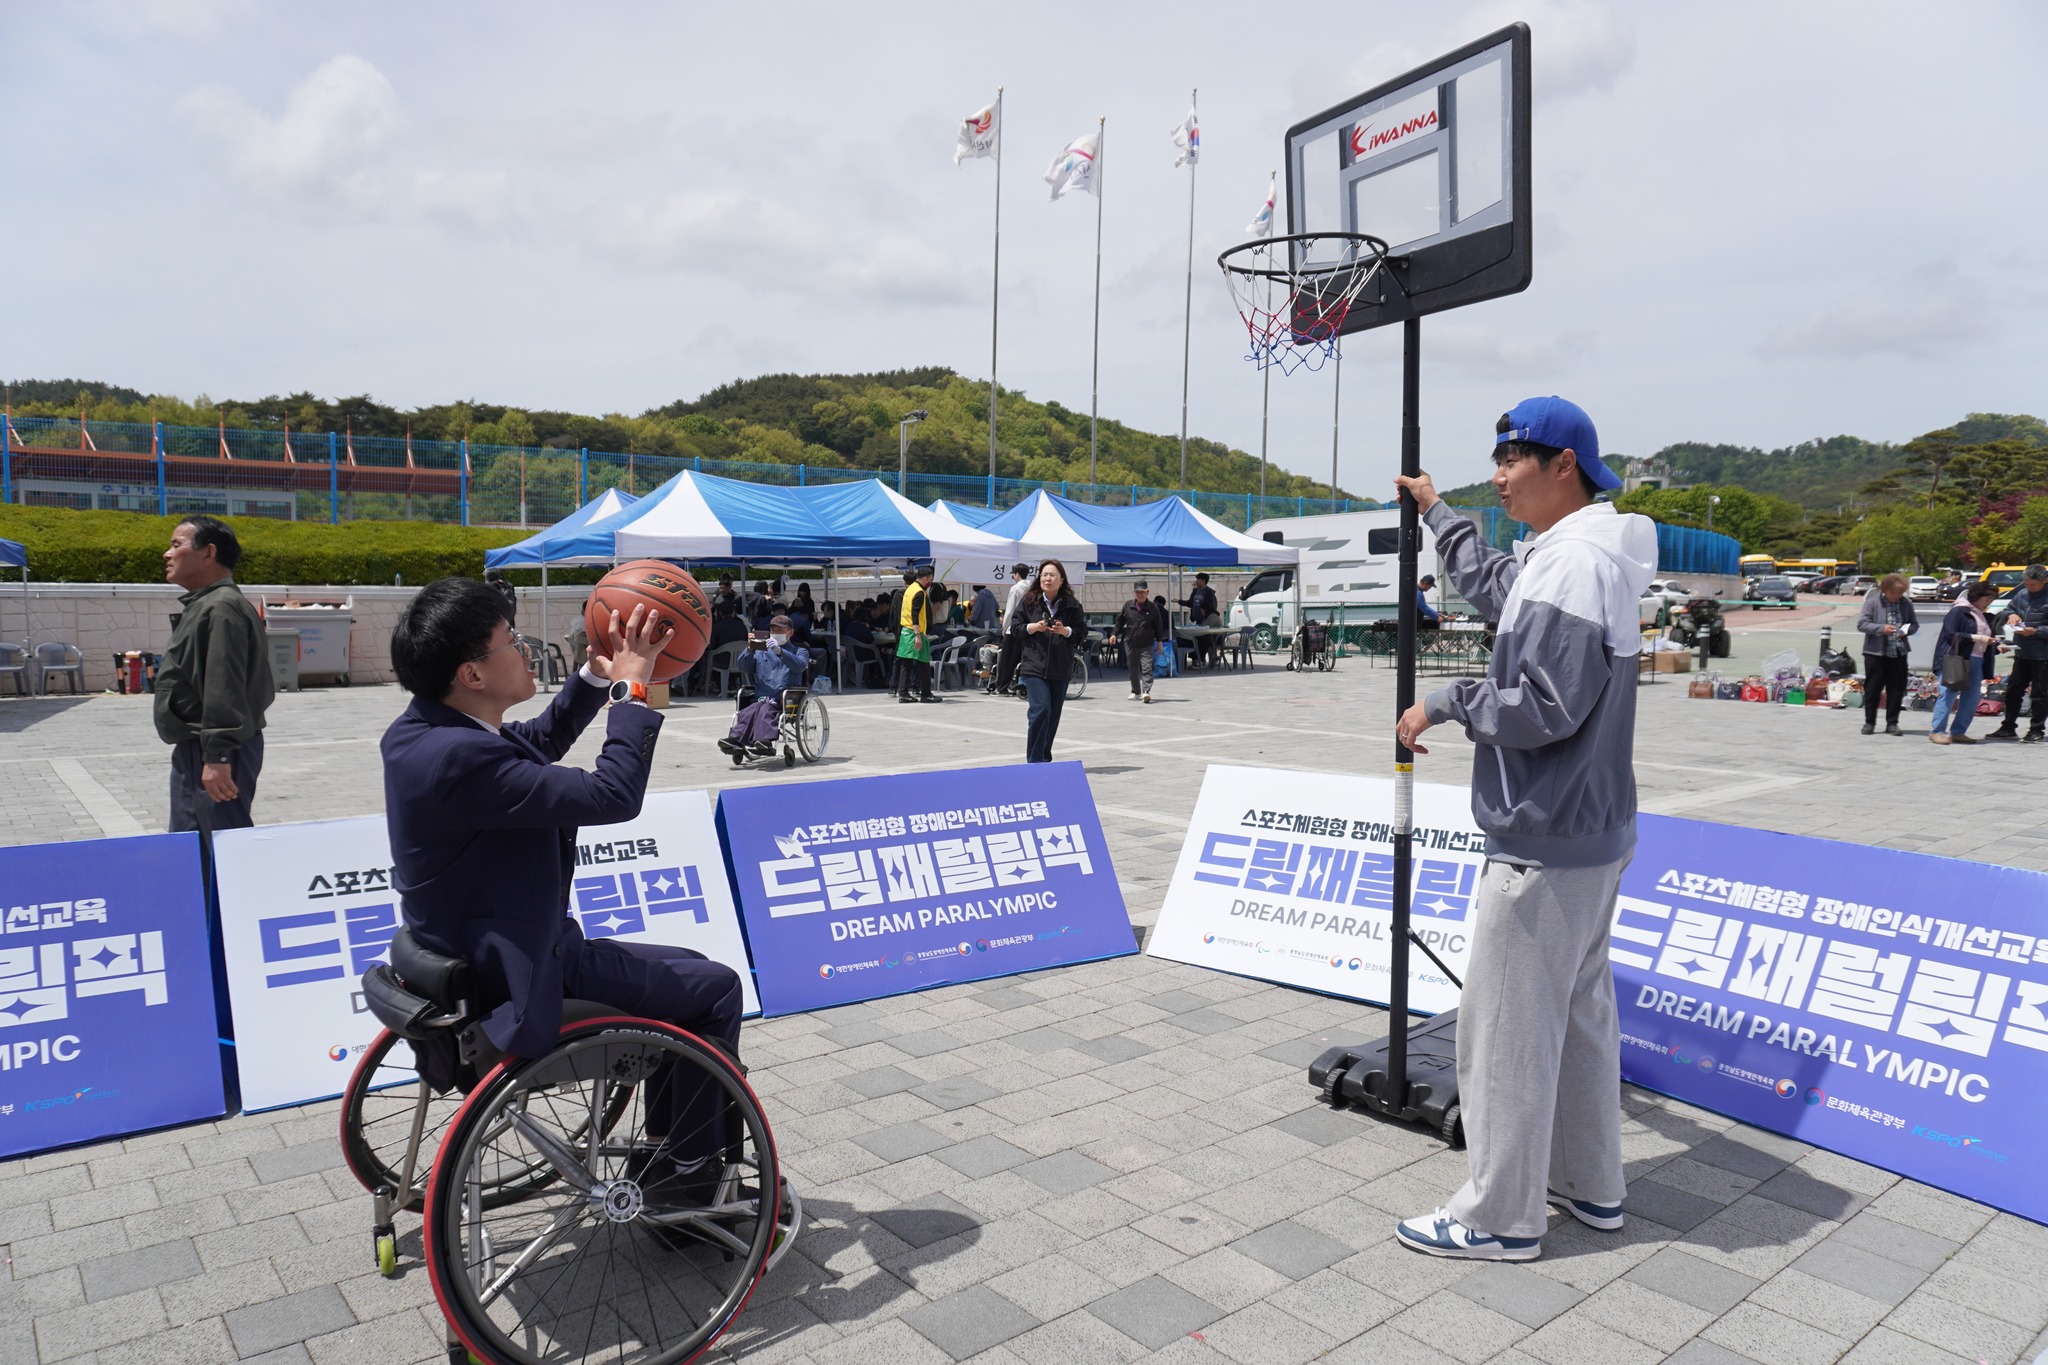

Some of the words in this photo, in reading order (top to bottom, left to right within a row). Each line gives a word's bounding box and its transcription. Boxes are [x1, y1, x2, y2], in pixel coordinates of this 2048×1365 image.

[790, 816, 906, 846] 스포츠체험형
[909, 800, 1050, 832] 장애인식개선교육
[1241, 808, 1348, 838] 스포츠체험형
[307, 866, 397, 899] 스포츠
[759, 824, 1094, 918] 드림패럴림픽
[1656, 869, 1810, 919] 스포츠체험형
[0, 897, 108, 935] 선교육
[830, 912, 915, 941] DREAM
[917, 891, 1058, 929] PARALYMPIC
[1230, 899, 1308, 928] DREAM
[990, 934, 1034, 948] 문화체육관광부
[1418, 973, 1449, 986] KSPO
[1636, 985, 1745, 1034] DREAM
[1747, 1014, 1990, 1103] PARALYMPIC
[24, 1095, 75, 1113] KSPO
[1826, 1096, 1906, 1129] 문화체육관광부
[1911, 1125, 1962, 1148] KSPO
